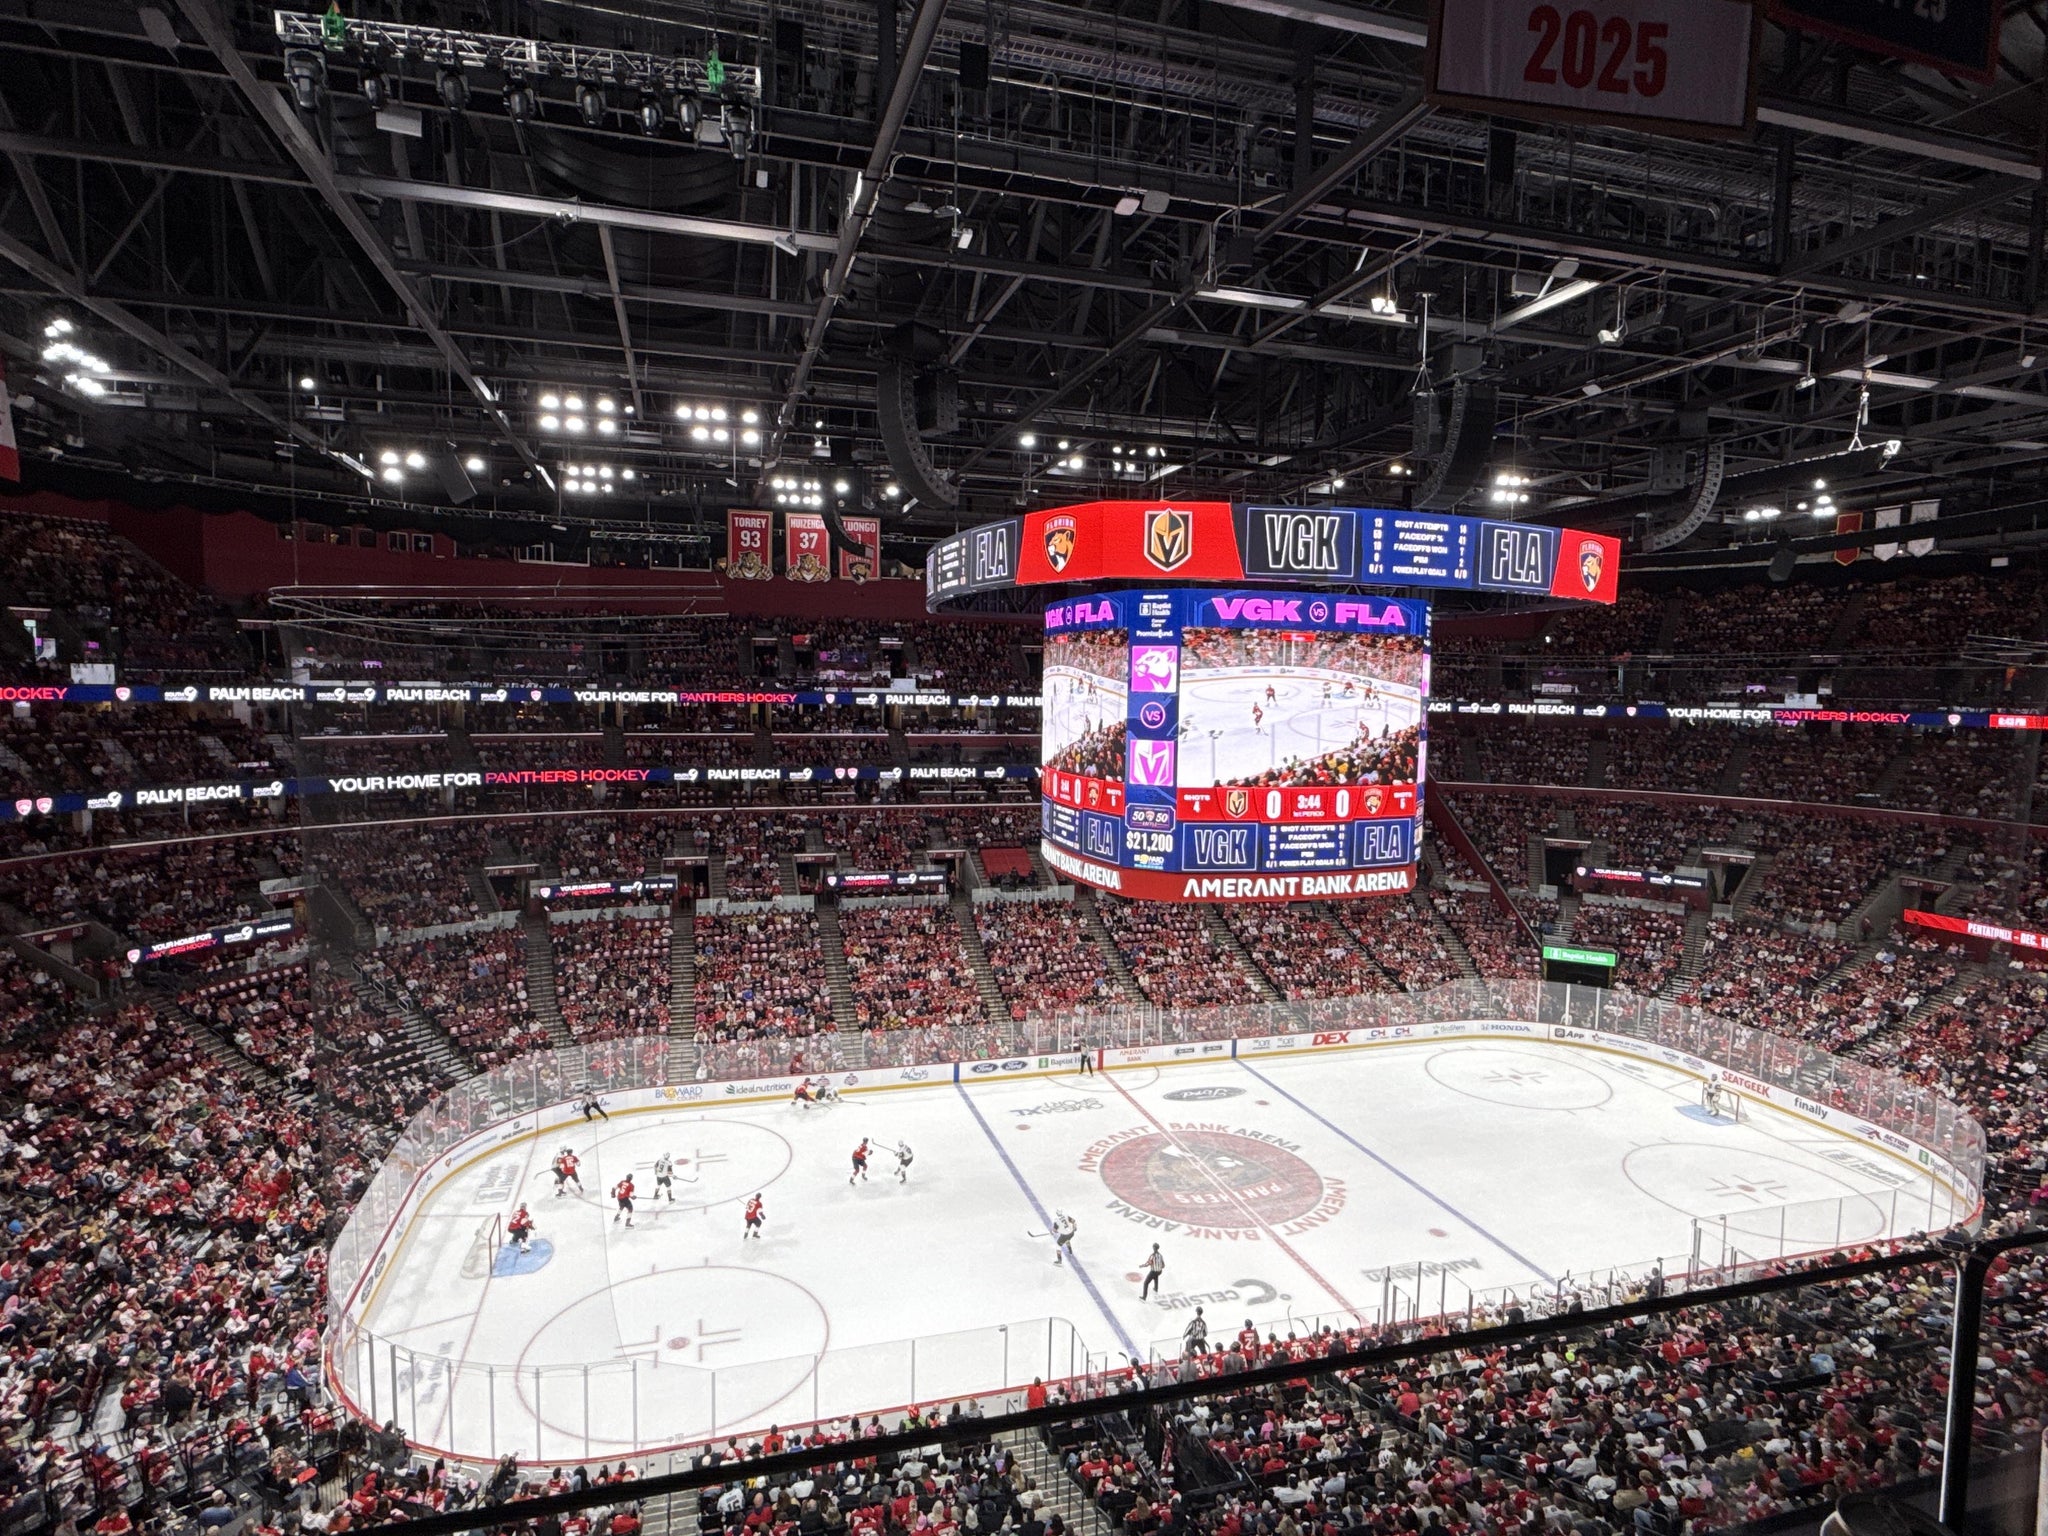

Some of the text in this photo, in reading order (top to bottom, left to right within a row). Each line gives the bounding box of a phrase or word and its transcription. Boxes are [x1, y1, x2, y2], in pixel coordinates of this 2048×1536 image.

[1524, 4, 1669, 98] 2025
[734, 516, 767, 528] TORREY
[1045, 516, 1075, 529] FLORIDA
[1395, 520, 1448, 532] SHOT ATTEMPTS
[740, 530, 761, 548] 93
[800, 532, 818, 549] 37
[1264, 514, 1340, 570] VGK
[1399, 532, 1436, 542] FACEOFF
[976, 528, 1008, 580] FLA
[1394, 543, 1431, 553] FACEOFFS
[1432, 546, 1448, 554] WON
[1492, 529, 1543, 584] FLA
[1392, 566, 1413, 574] POWER
[1414, 567, 1428, 575] PLAY
[1428, 568, 1446, 576] GOALS
[1045, 600, 1114, 629] VGK FLA
[1212, 598, 1302, 622] VGK
[1313, 607, 1325, 617] VS
[1335, 602, 1406, 626] FLA
[184, 686, 198, 702] 9
[210, 688, 304, 700] PALM BEACH
[334, 688, 346, 701] 9
[364, 688, 376, 701] 9
[386, 689, 470, 701] PALM BEACH
[574, 691, 797, 703] YOUR HOME FOR PANTHERS HOCKEY
[886, 694, 950, 705] PALM BEACH
[1007, 696, 1033, 706] PALM
[1428, 702, 1450, 712] ACH
[1145, 710, 1161, 721] VS
[1508, 704, 1574, 715] PALM BEACH
[1667, 708, 1910, 724] YOUR HOME FOR PANTHERS HOCKEY
[708, 769, 780, 780] PALM BEACH
[910, 767, 976, 778] PALM BEACH
[329, 769, 650, 793] YOUR HOME FOR PANTHERS HOCKEY
[136, 785, 242, 804] PALM BEACH
[271, 781, 284, 796] 9
[1074, 778, 1082, 804] 0
[108, 792, 122, 808] 9
[1266, 790, 1282, 819] 0
[1298, 794, 1321, 810] 3:44
[1336, 789, 1350, 818] 0
[1193, 801, 1200, 813] 4
[1132, 811, 1168, 822] 50 50
[1302, 810, 1325, 818] PERIOD
[1088, 818, 1114, 856] FLA
[1126, 831, 1174, 852] $21,200
[1364, 825, 1401, 860] FLA
[1194, 829, 1248, 865] VGK
[1280, 842, 1318, 850] FACEOFFS
[1315, 858, 1334, 866] GOALS
[1060, 855, 1122, 890] BANK ARENA
[1183, 870, 1409, 898] AMERANT BANK ARENA
[1968, 922, 2038, 946] PENTATONIX DEC.
[152, 932, 212, 952] YOUR HOME FOR
[186, 938, 218, 951] HOCKEY
[1562, 952, 1608, 962] Baptist Health
[1490, 1024, 1532, 1032] HONDA
[1312, 1032, 1350, 1046] DEX
[1120, 1048, 1150, 1056] AMERANT
[976, 1064, 994, 1073] Ford
[1004, 1061, 1023, 1070] Ford
[1051, 1058, 1074, 1066] Baptist
[736, 1083, 792, 1094] idealnutrition
[1722, 1070, 1771, 1098] SEATGEEK
[655, 1086, 702, 1098] BROWARD
[1182, 1088, 1228, 1098] Ford
[1794, 1096, 1828, 1120] finally
[1078, 1122, 1302, 1174] AMERANT BANK ARENA
[1176, 1181, 1282, 1205] PANTHERS
[1105, 1176, 1348, 1242] AMERANT BANK ARENA
[1157, 1289, 1240, 1311] CELSIUS
